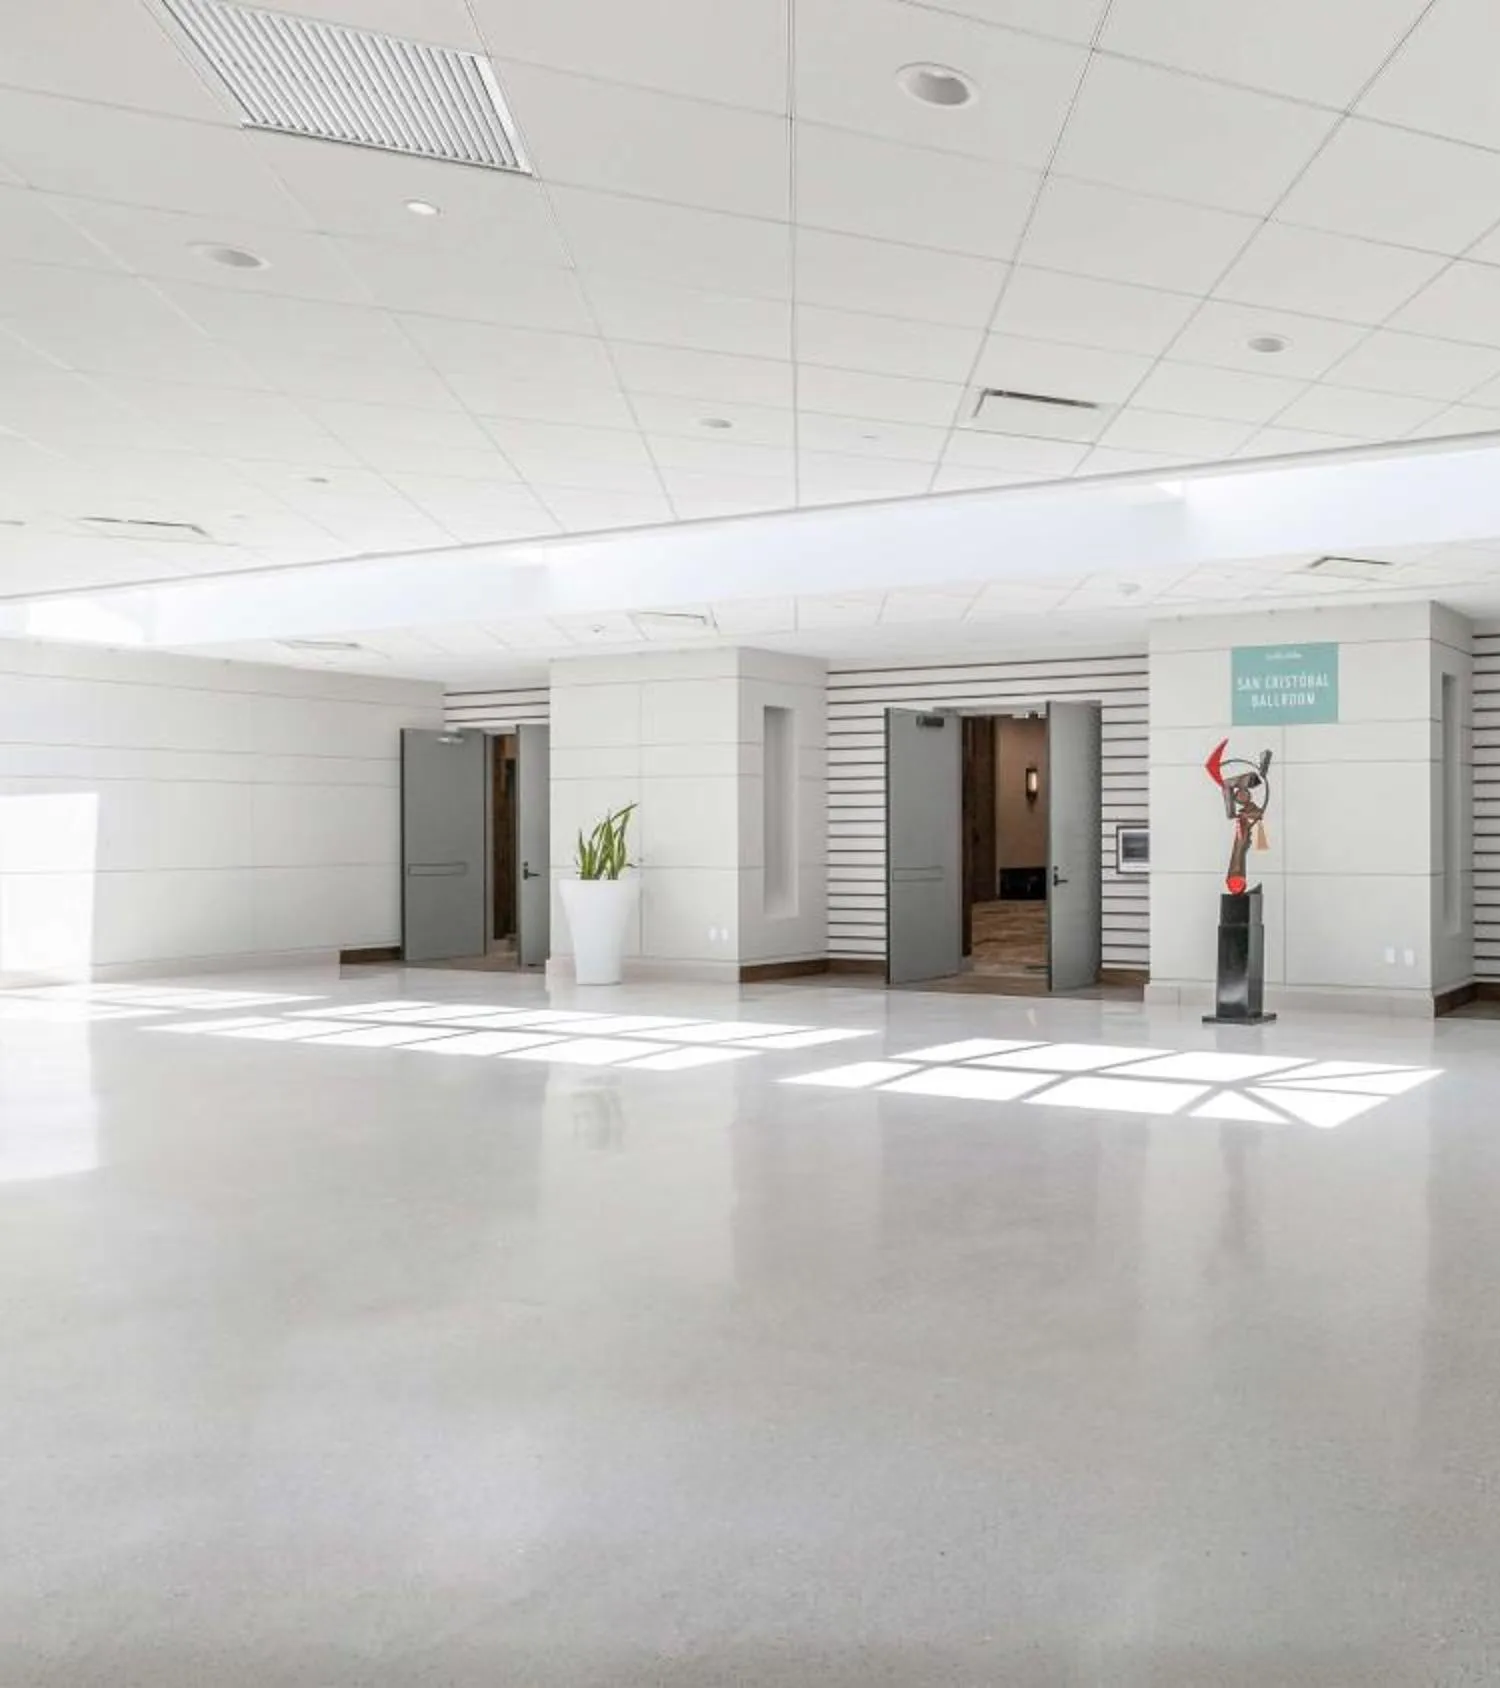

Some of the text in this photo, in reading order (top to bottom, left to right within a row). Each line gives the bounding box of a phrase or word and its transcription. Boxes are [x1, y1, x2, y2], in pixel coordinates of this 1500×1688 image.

[1237, 671, 1329, 690] SAN CRISTÓBAL
[1251, 692, 1316, 708] BALLROOM
